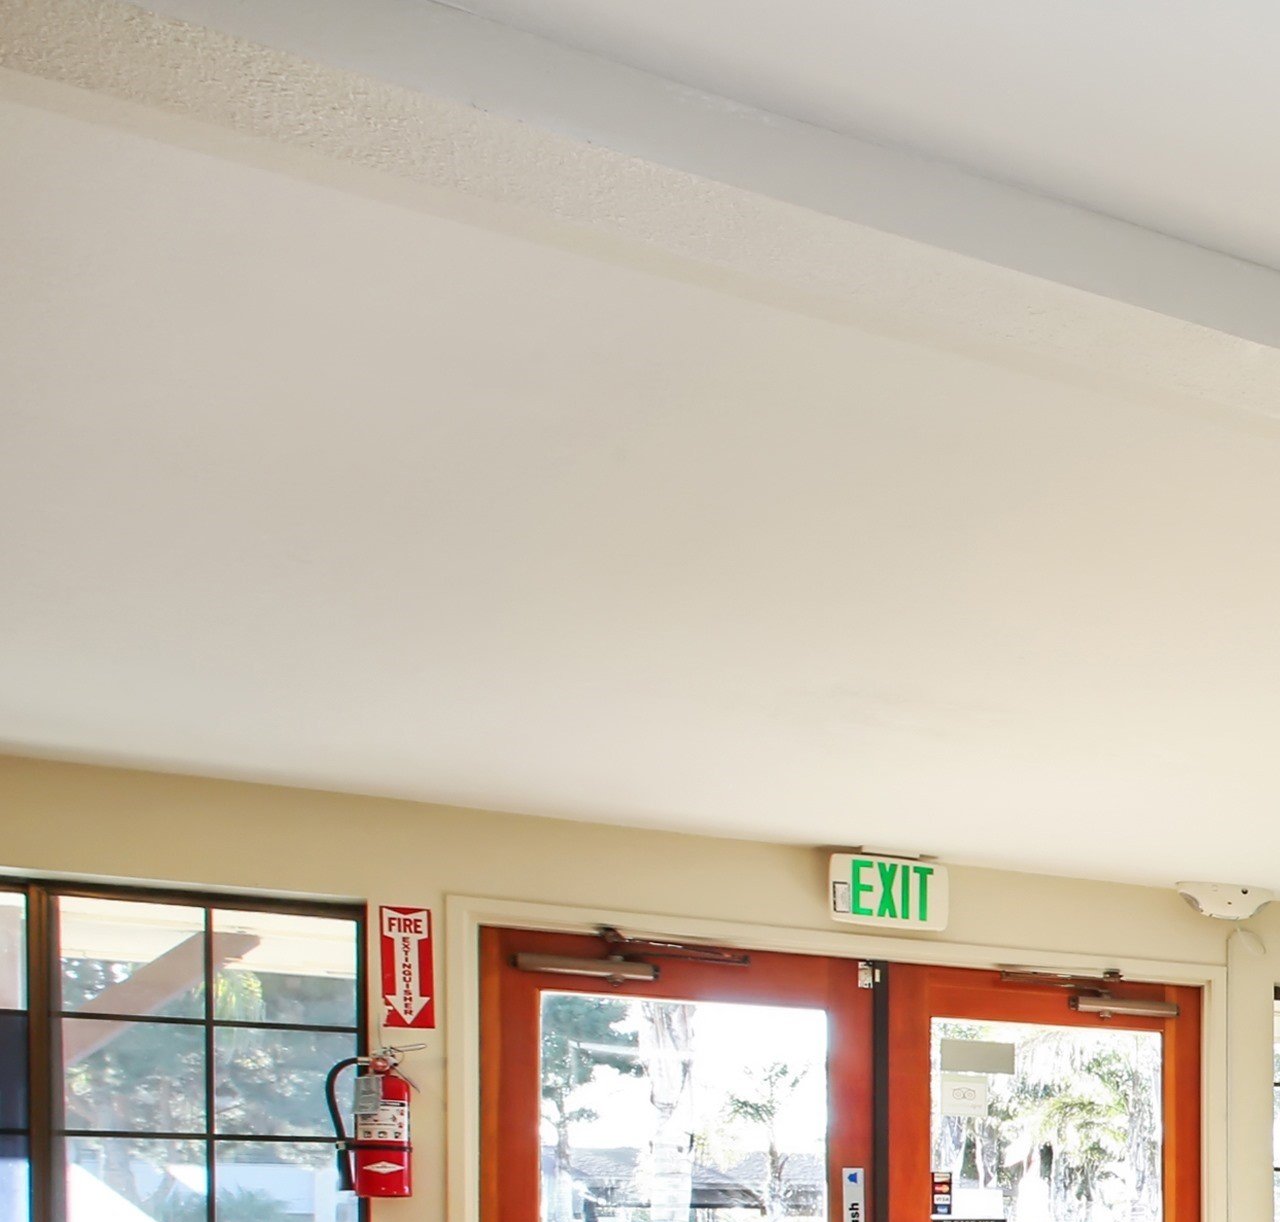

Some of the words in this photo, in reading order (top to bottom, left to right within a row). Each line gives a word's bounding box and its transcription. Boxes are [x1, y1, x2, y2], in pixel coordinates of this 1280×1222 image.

[851, 859, 934, 922] EXIT
[387, 917, 423, 934] FIRE
[402, 936, 413, 1015] EXTINGUISHER
